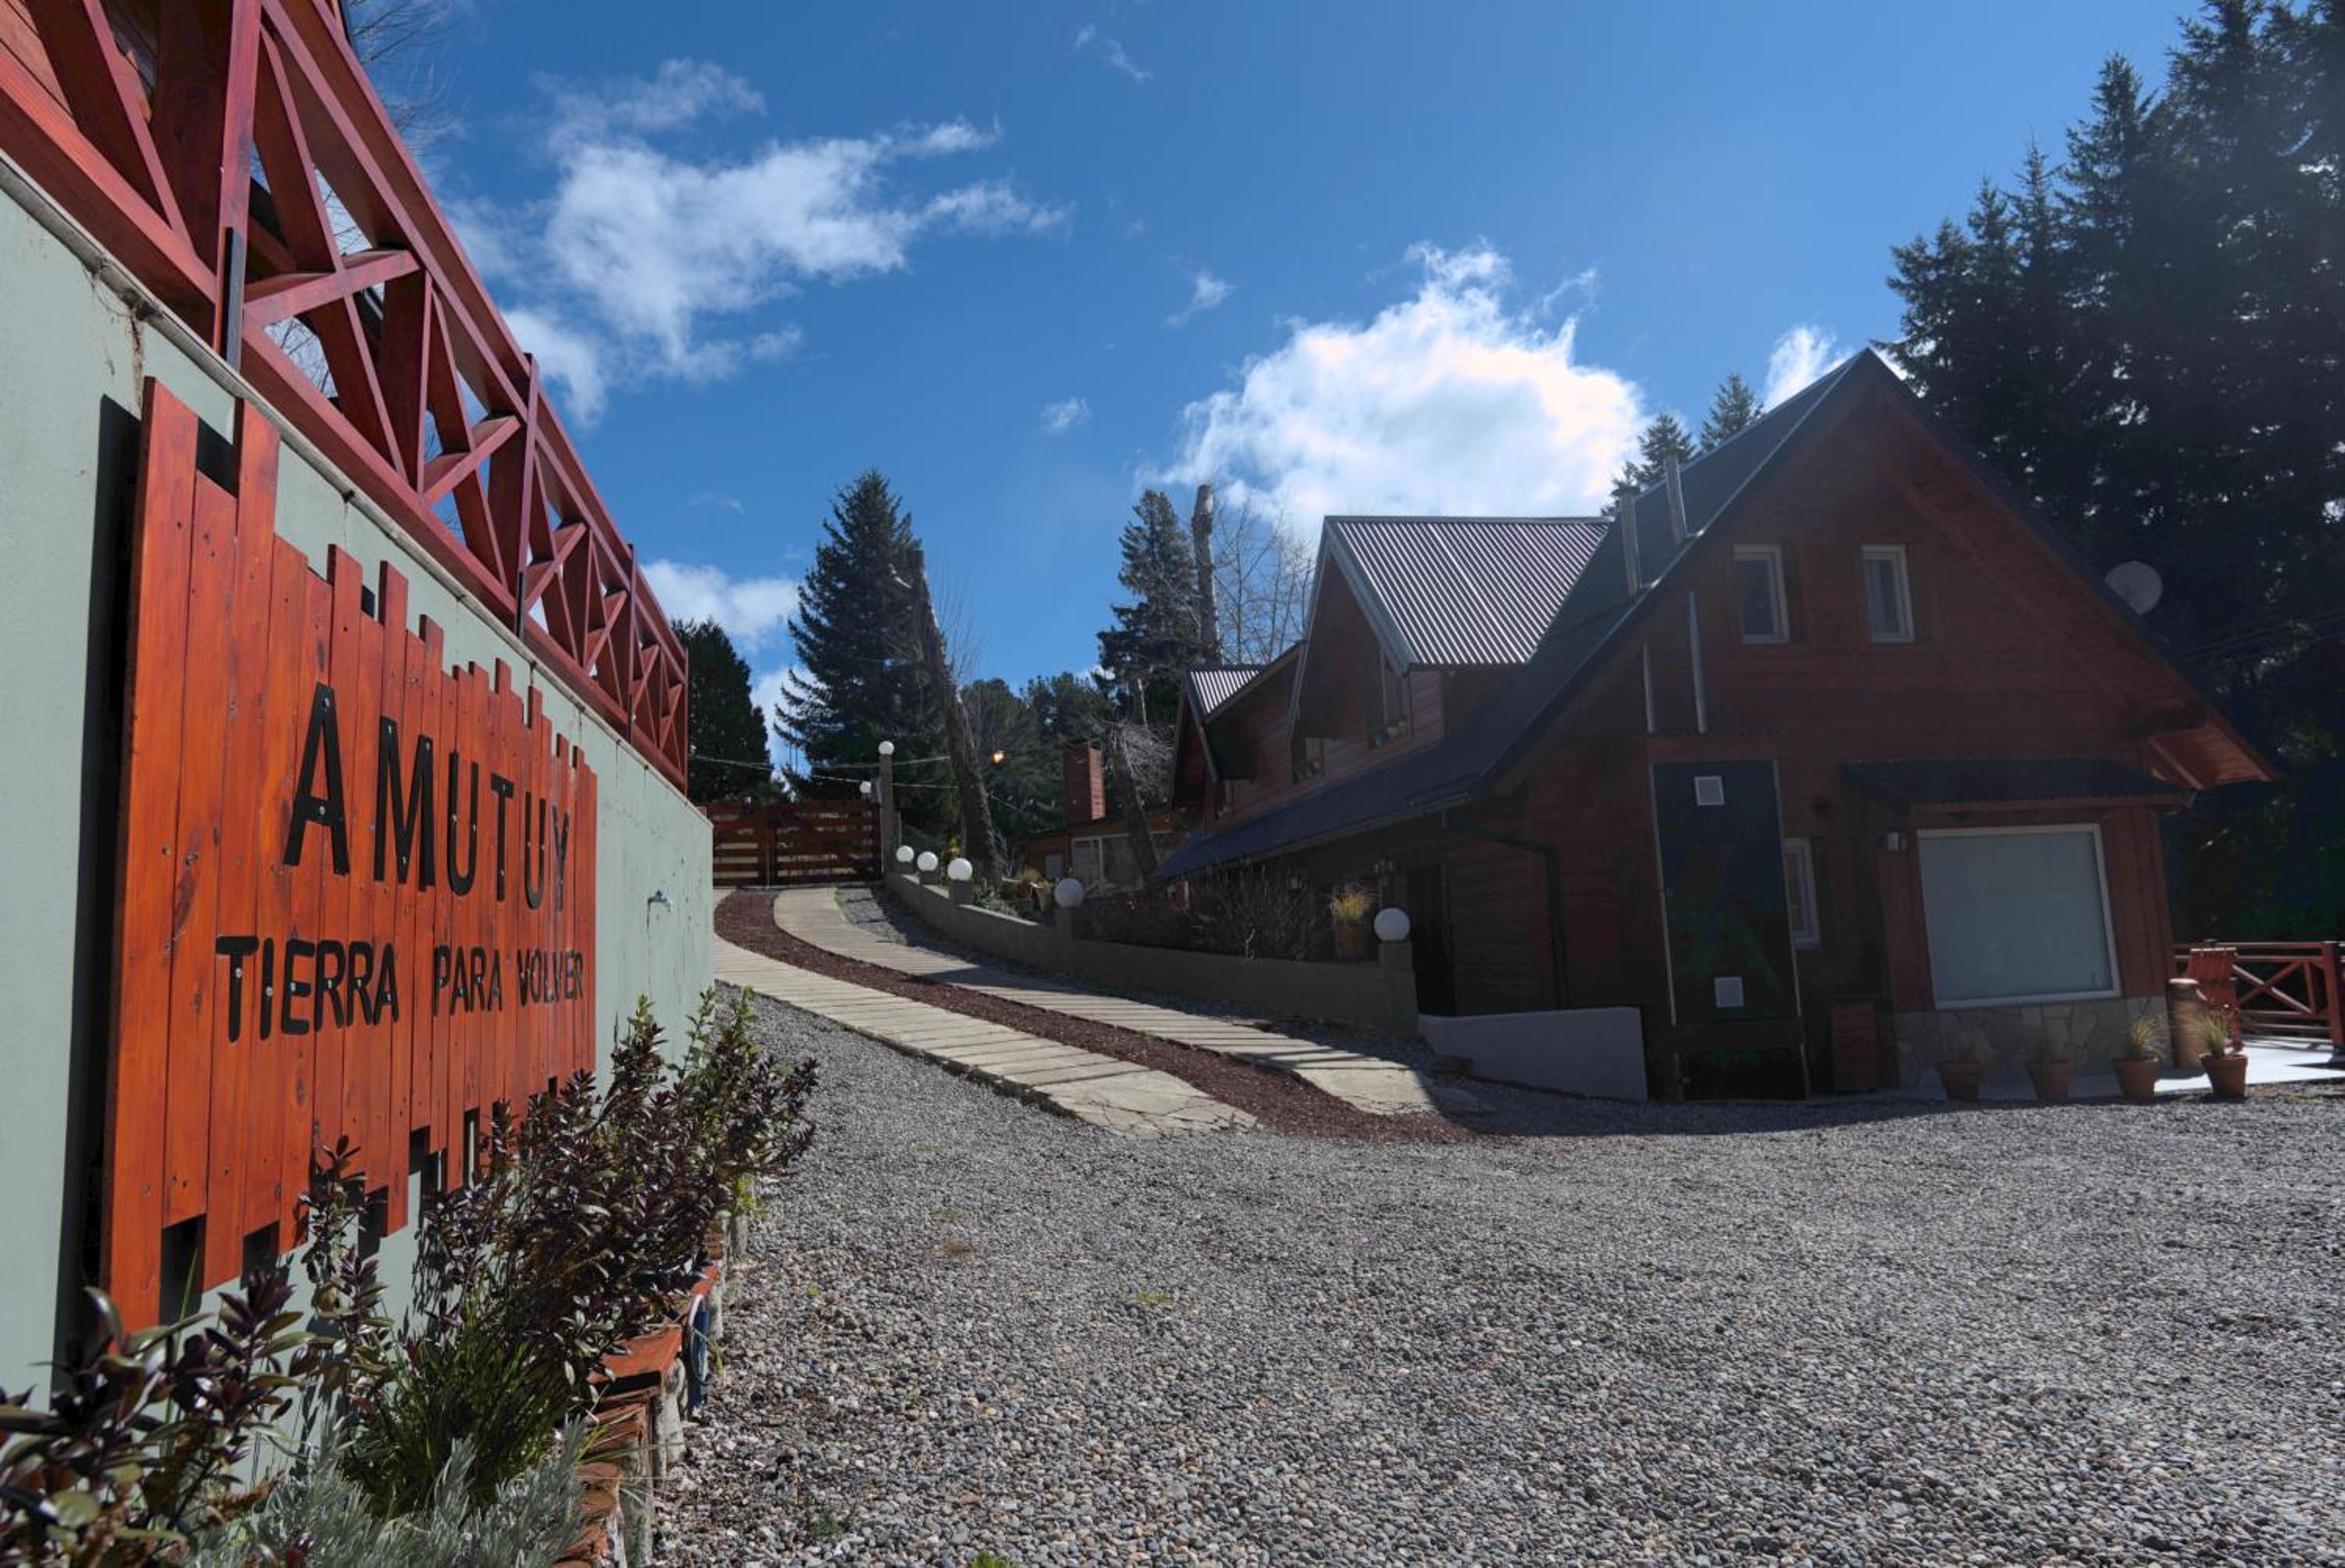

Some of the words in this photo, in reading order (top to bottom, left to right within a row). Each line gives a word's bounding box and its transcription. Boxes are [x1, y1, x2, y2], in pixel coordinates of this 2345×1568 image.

[283, 682, 570, 911] AMUTUY
[215, 936, 399, 1043] TIERRA
[432, 944, 503, 1015] PARA
[516, 948, 585, 1006] VOLVER
